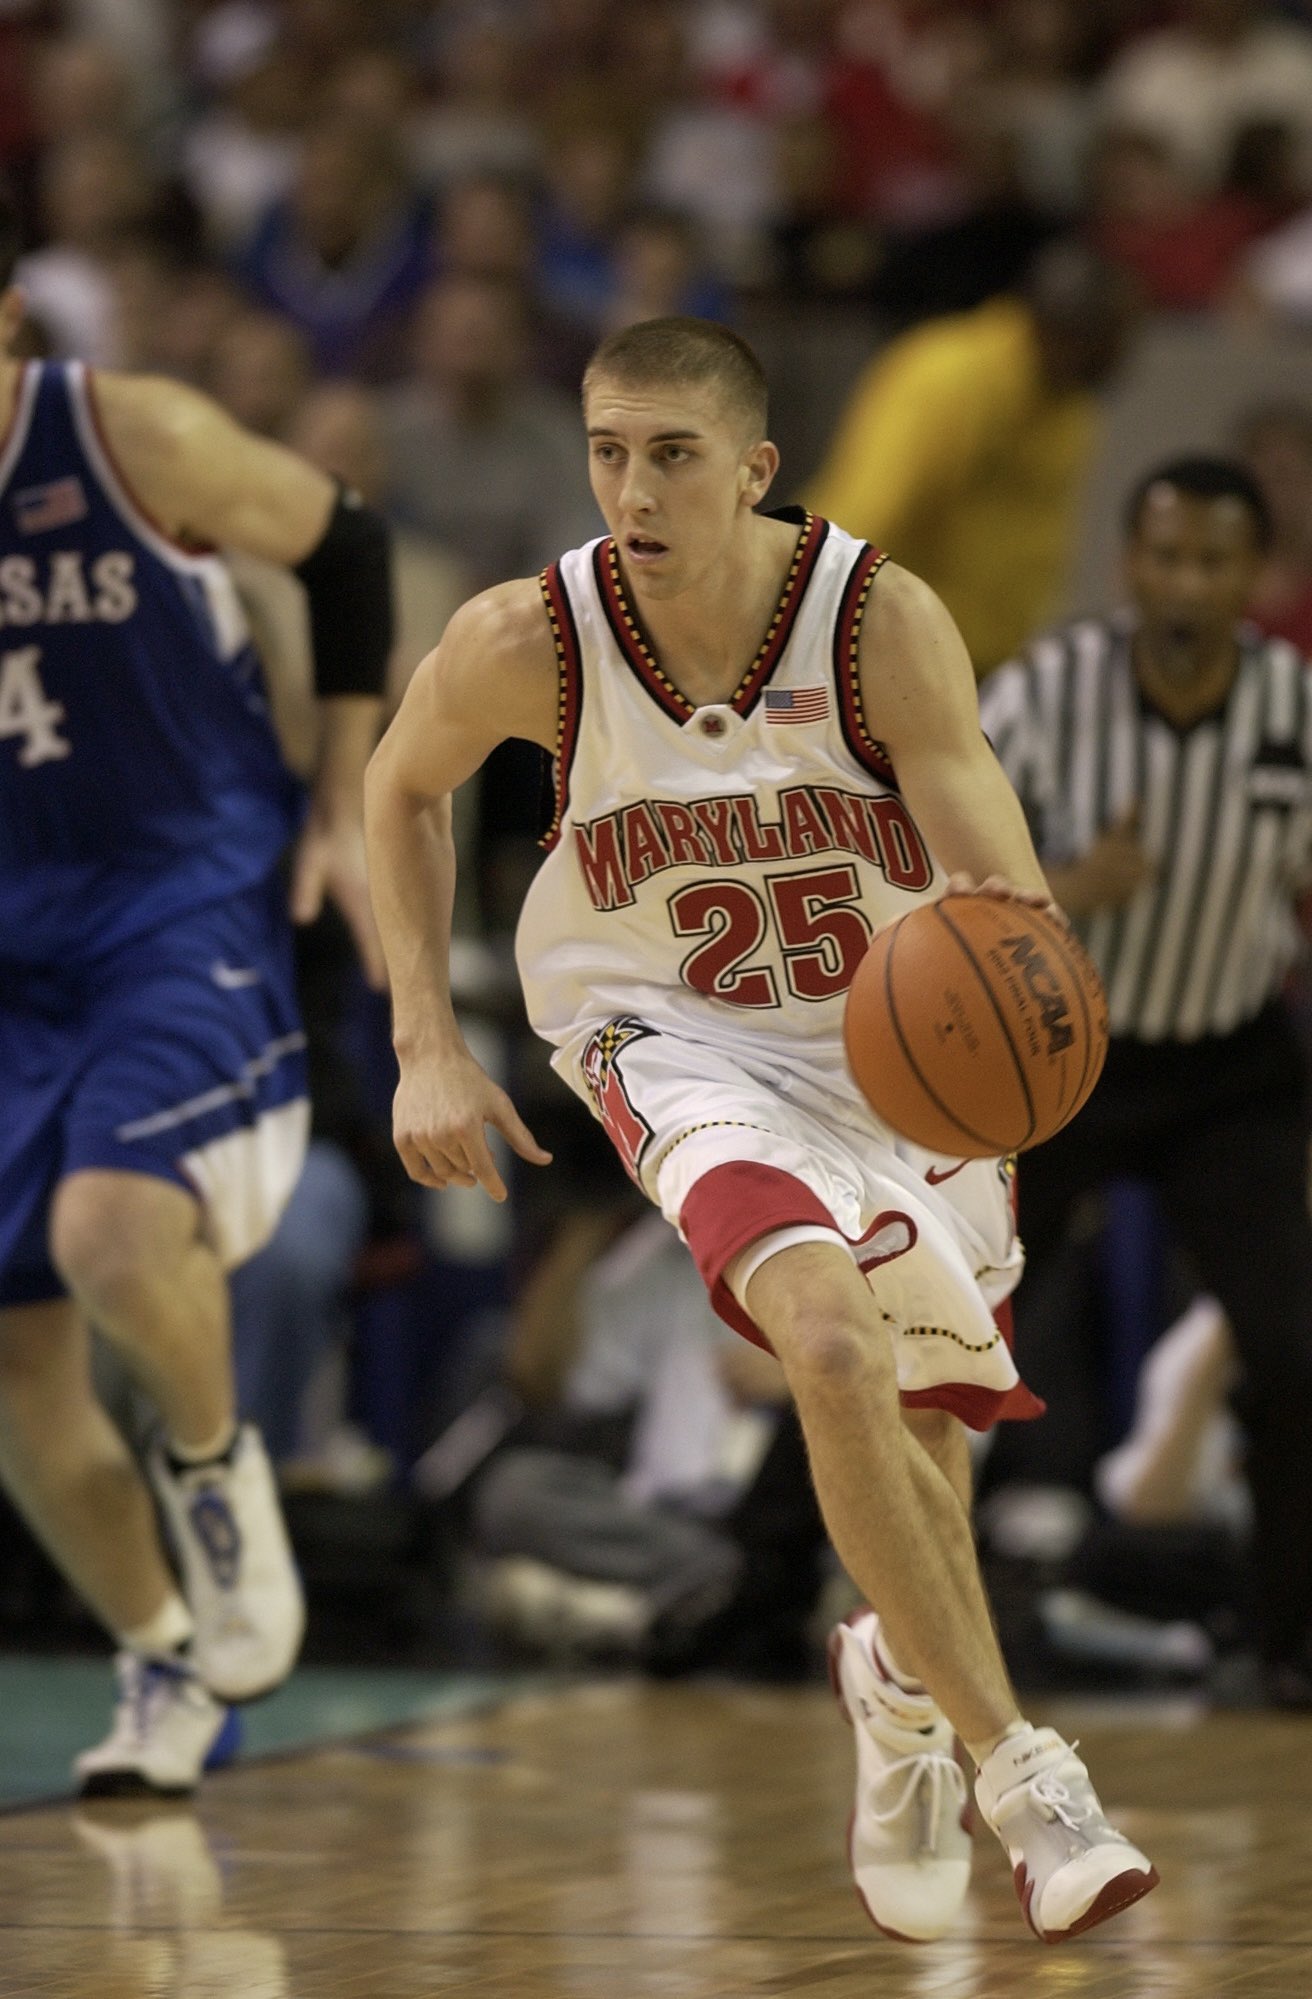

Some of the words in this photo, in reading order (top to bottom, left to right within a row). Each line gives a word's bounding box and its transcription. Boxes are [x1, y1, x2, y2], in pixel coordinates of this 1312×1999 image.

[572, 784, 934, 912] MARYLAND
[666, 863, 874, 1009] 25
[1000, 933, 1076, 1056] NCAA
